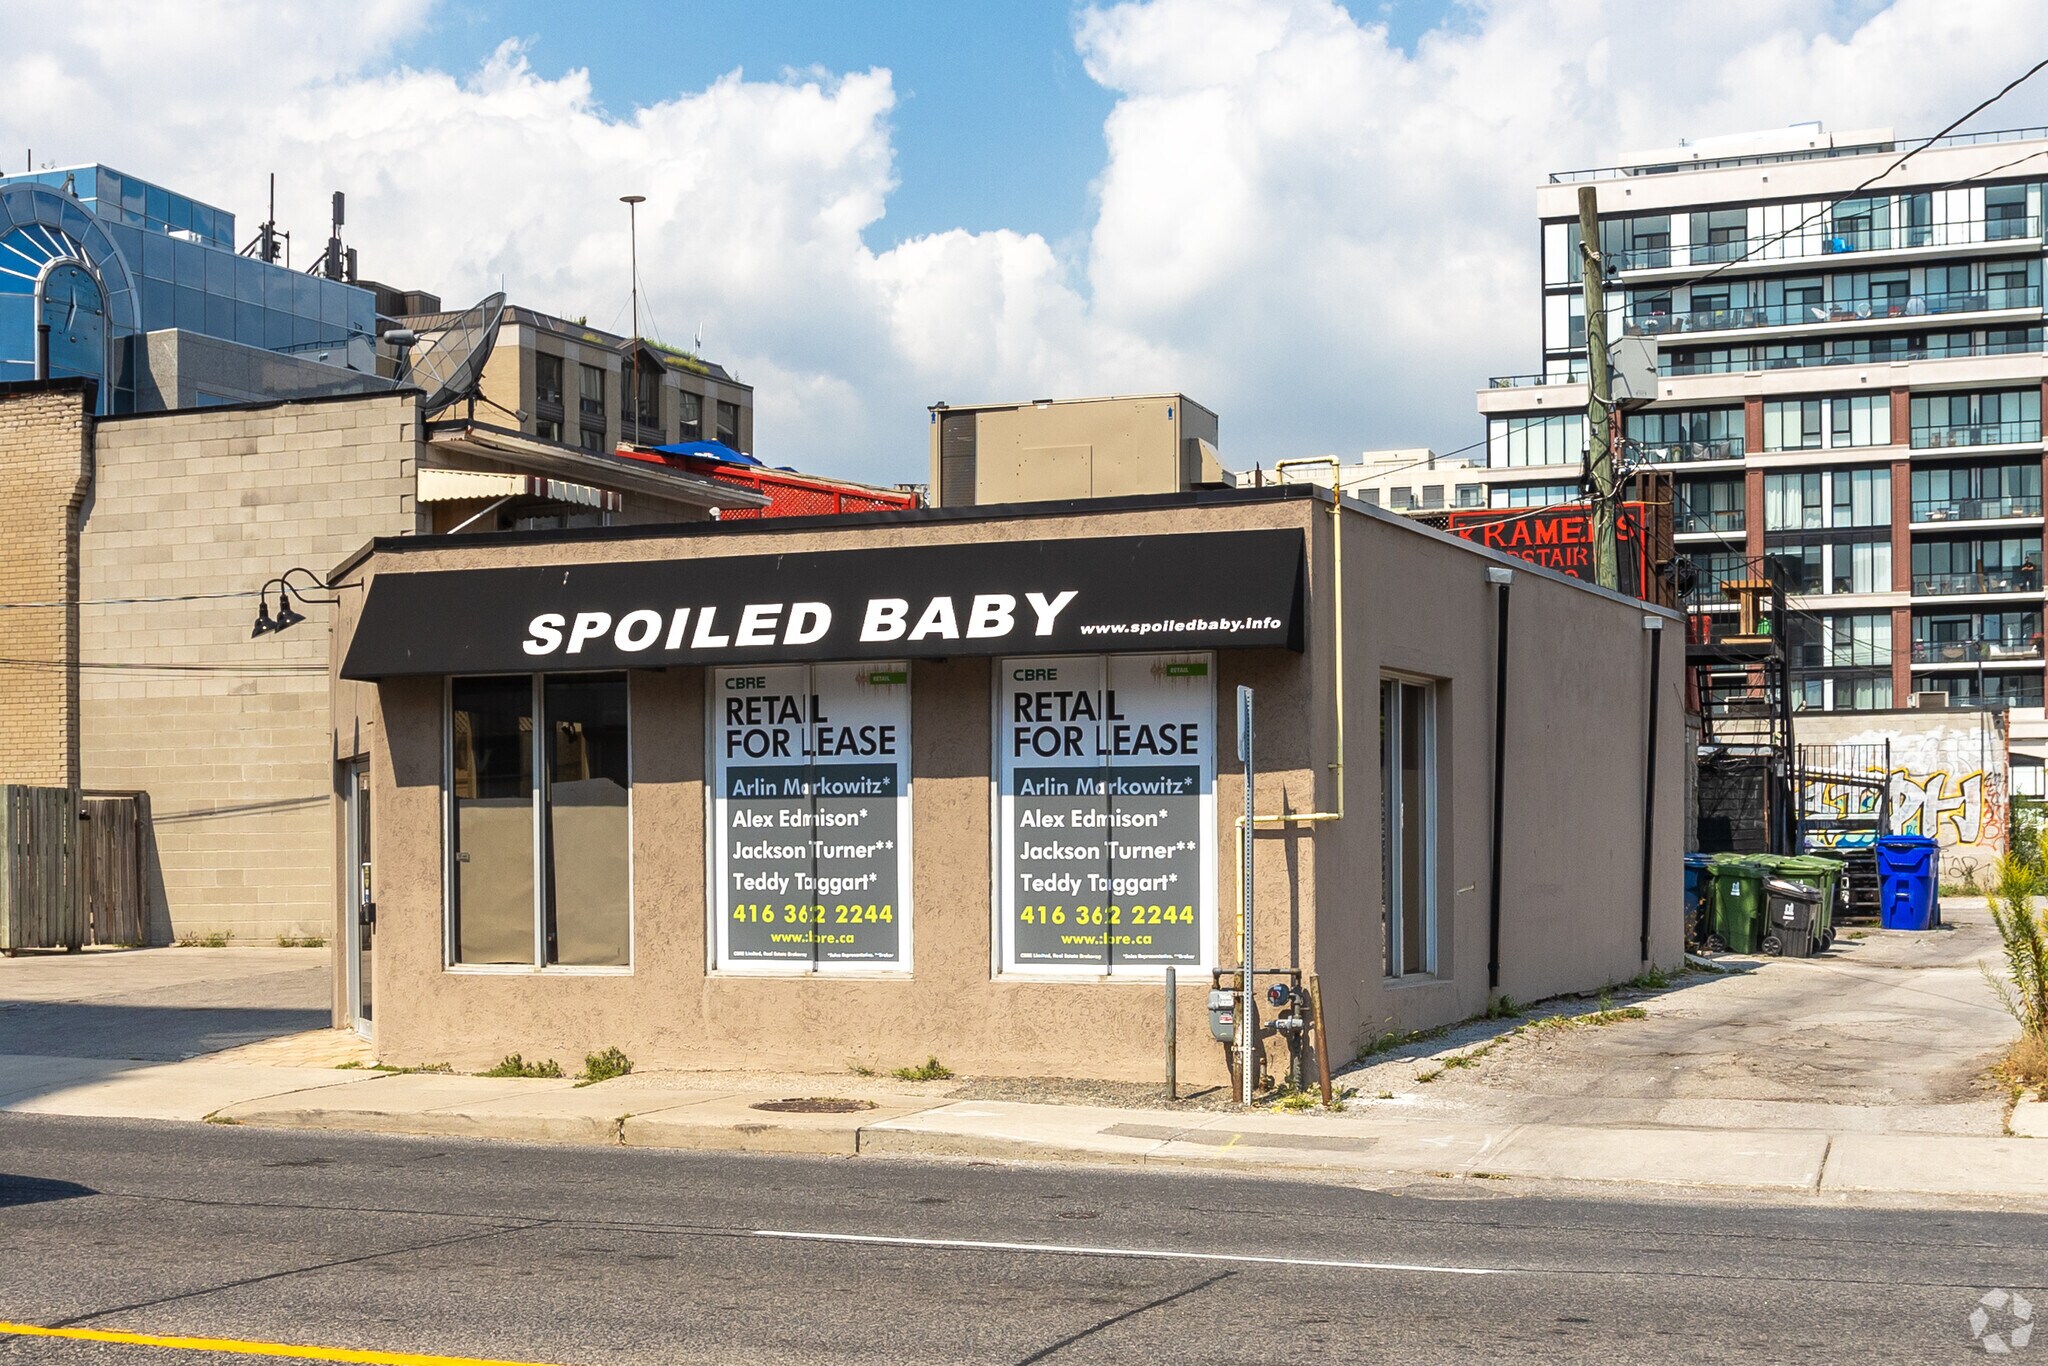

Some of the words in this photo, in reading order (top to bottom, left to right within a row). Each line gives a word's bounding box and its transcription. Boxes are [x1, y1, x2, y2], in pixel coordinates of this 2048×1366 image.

[1457, 514, 1636, 548] KRAMES
[522, 602, 832, 656] SPOILED
[859, 590, 1078, 642] BABY
[1080, 616, 1282, 636] www.spoiledbaby.info
[725, 676, 766, 690] CBRE
[1013, 669, 1058, 682] CBRE
[726, 694, 828, 726] RETAIL
[1014, 690, 1125, 723] RETAIL
[726, 728, 791, 759] FOR
[802, 725, 896, 756] LEASE
[1014, 725, 1083, 757] FOR
[1096, 723, 1198, 755] LEASE
[732, 779, 777, 797] Arlin
[1020, 778, 1068, 796] Arlin
[732, 809, 773, 828] Alex
[1020, 809, 1065, 828] Alex
[732, 841, 806, 861] Jackson
[1020, 841, 1099, 861] Jackson
[732, 873, 790, 895] Teddy
[1020, 873, 1082, 896] Teddy
[733, 904, 775, 923] 416
[784, 904, 826, 924] 362
[835, 904, 893, 924] 2244
[1020, 905, 1066, 925] 416
[1075, 905, 1121, 925] 362
[1131, 905, 1194, 925] 2244
